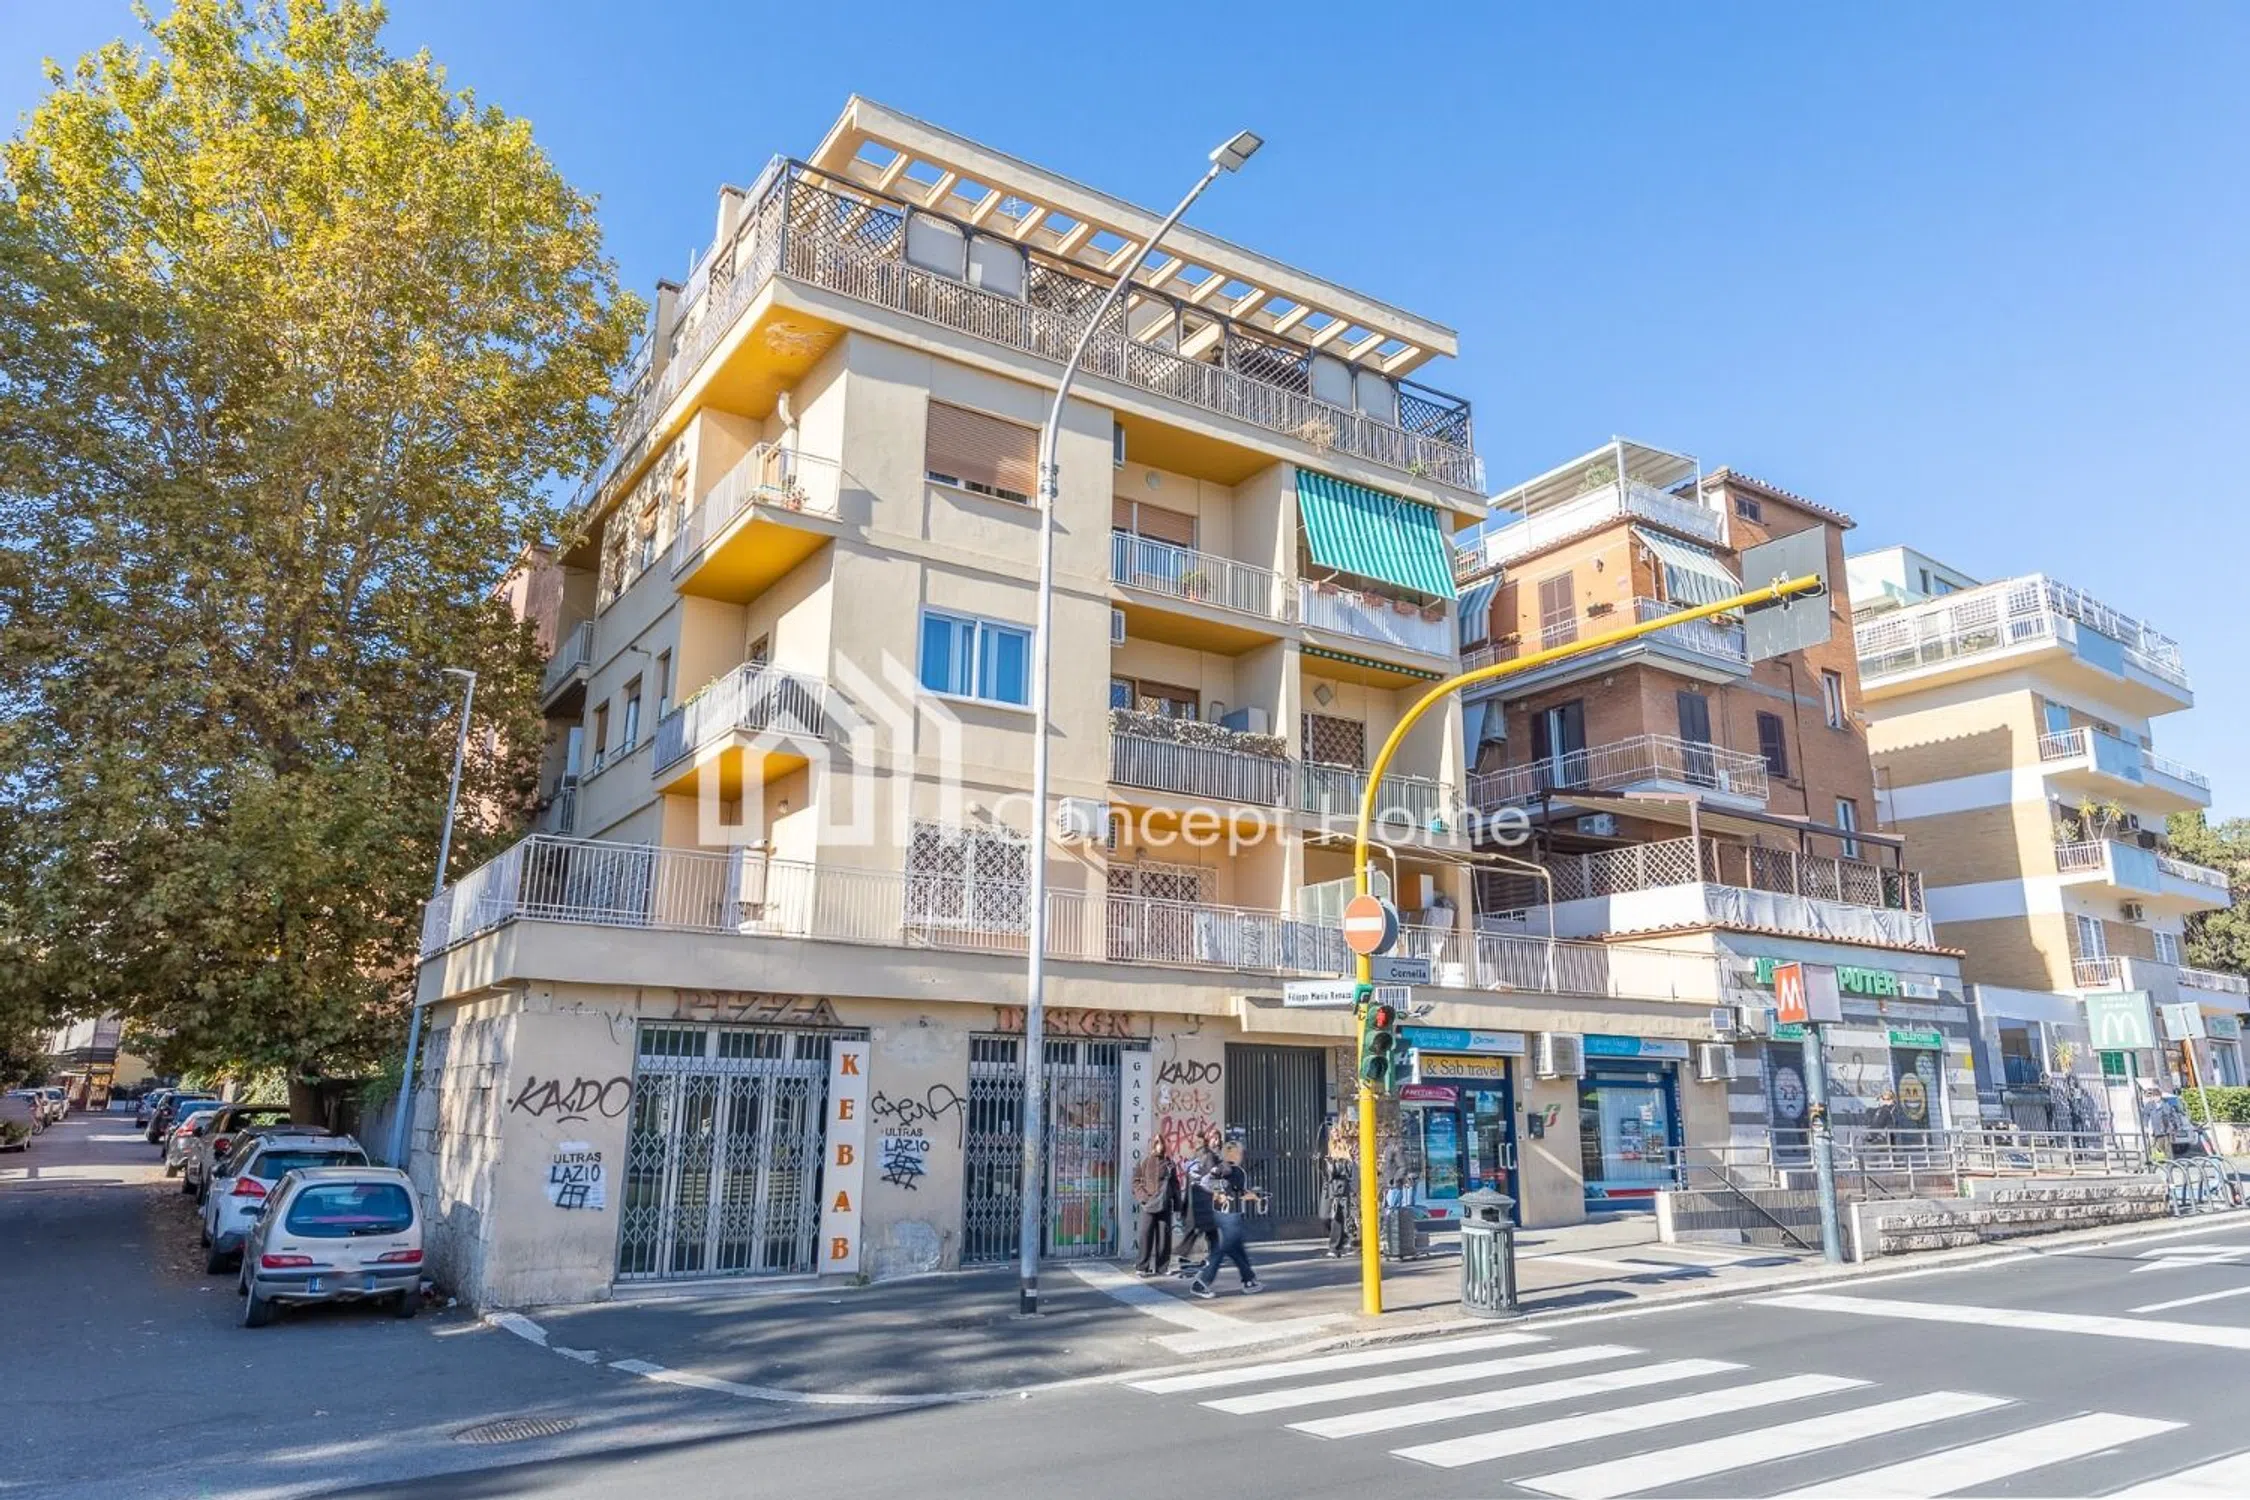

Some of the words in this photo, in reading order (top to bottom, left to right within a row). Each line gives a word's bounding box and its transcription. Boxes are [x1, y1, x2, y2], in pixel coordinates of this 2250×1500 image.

[1780, 976, 1804, 1012] M
[1837, 966, 1898, 996] PUTER
[672, 988, 843, 1026] PIZZA
[993, 1006, 1133, 1038] DSIGN
[1440, 1059, 1464, 1076] Sab
[1467, 1061, 1500, 1077] travel
[885, 1128, 923, 1138] ULTRAS
[885, 1138, 930, 1153] LAZIO
[553, 1152, 602, 1164] ULTRAS
[830, 1053, 860, 1260] KEBAB
[1131, 1061, 1142, 1250] GASTROMIA
[550, 1164, 601, 1185] LAZIO
